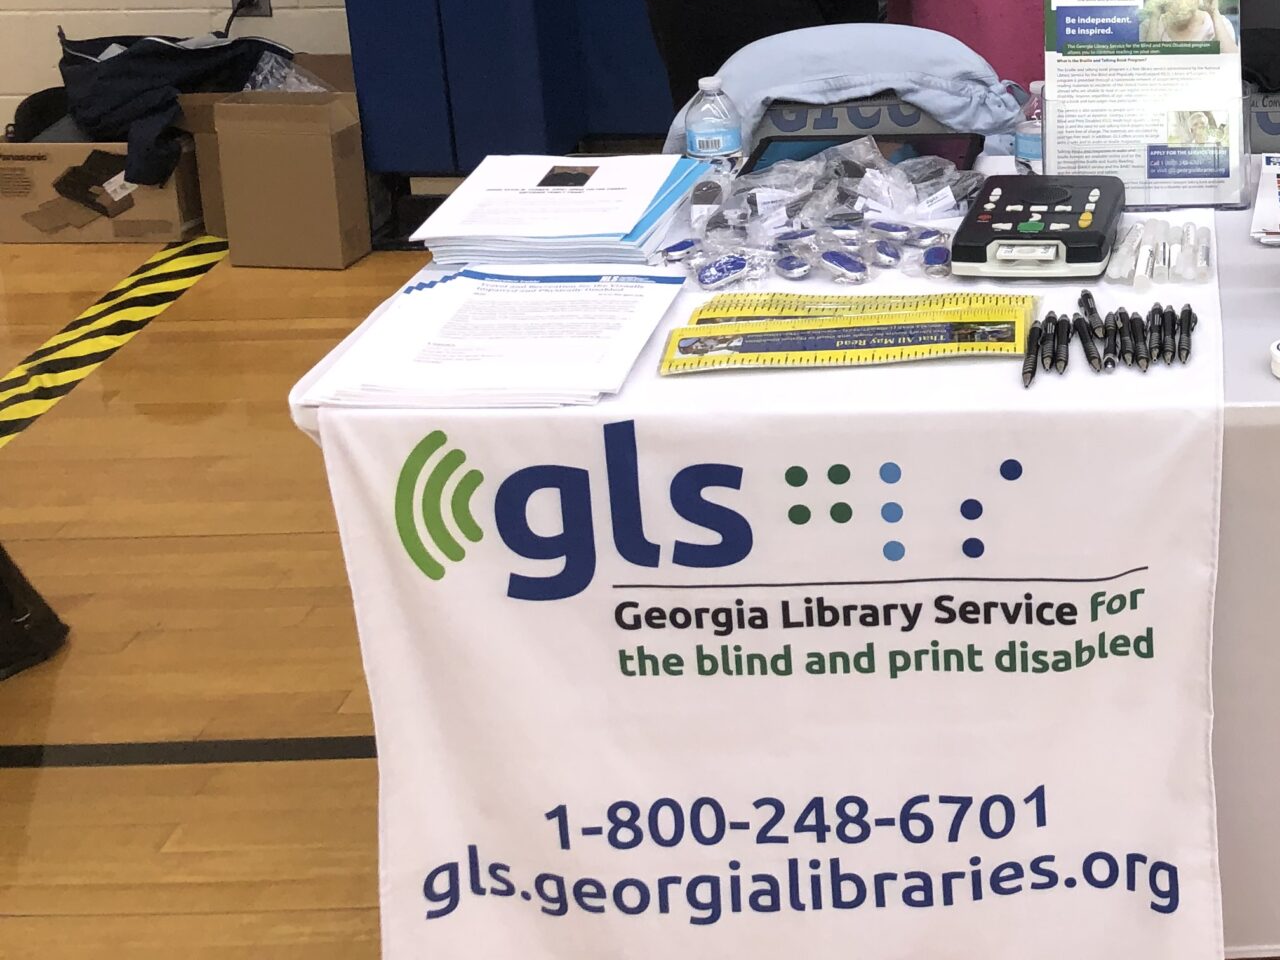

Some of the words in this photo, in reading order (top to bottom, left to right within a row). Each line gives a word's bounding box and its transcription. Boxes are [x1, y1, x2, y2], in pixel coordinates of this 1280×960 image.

[1066, 16, 1076, 24] Be
[1078, 16, 1132, 26] independent.
[1066, 27, 1076, 35] Be
[1078, 27, 1113, 36] inspired.
[835, 339, 866, 347] Read
[870, 337, 894, 346] May
[494, 419, 754, 601] gls
[614, 601, 769, 636] Georgia
[782, 597, 923, 633] Library
[934, 592, 1077, 629] Service
[1090, 585, 1146, 623] for
[618, 646, 685, 678] the
[696, 643, 793, 677] blind
[804, 641, 876, 676] and
[889, 639, 985, 679] print
[995, 627, 1155, 675] disabled
[544, 785, 1049, 852] 1-800-248-6701
[423, 844, 1180, 926] gls.georgialibraries.org
